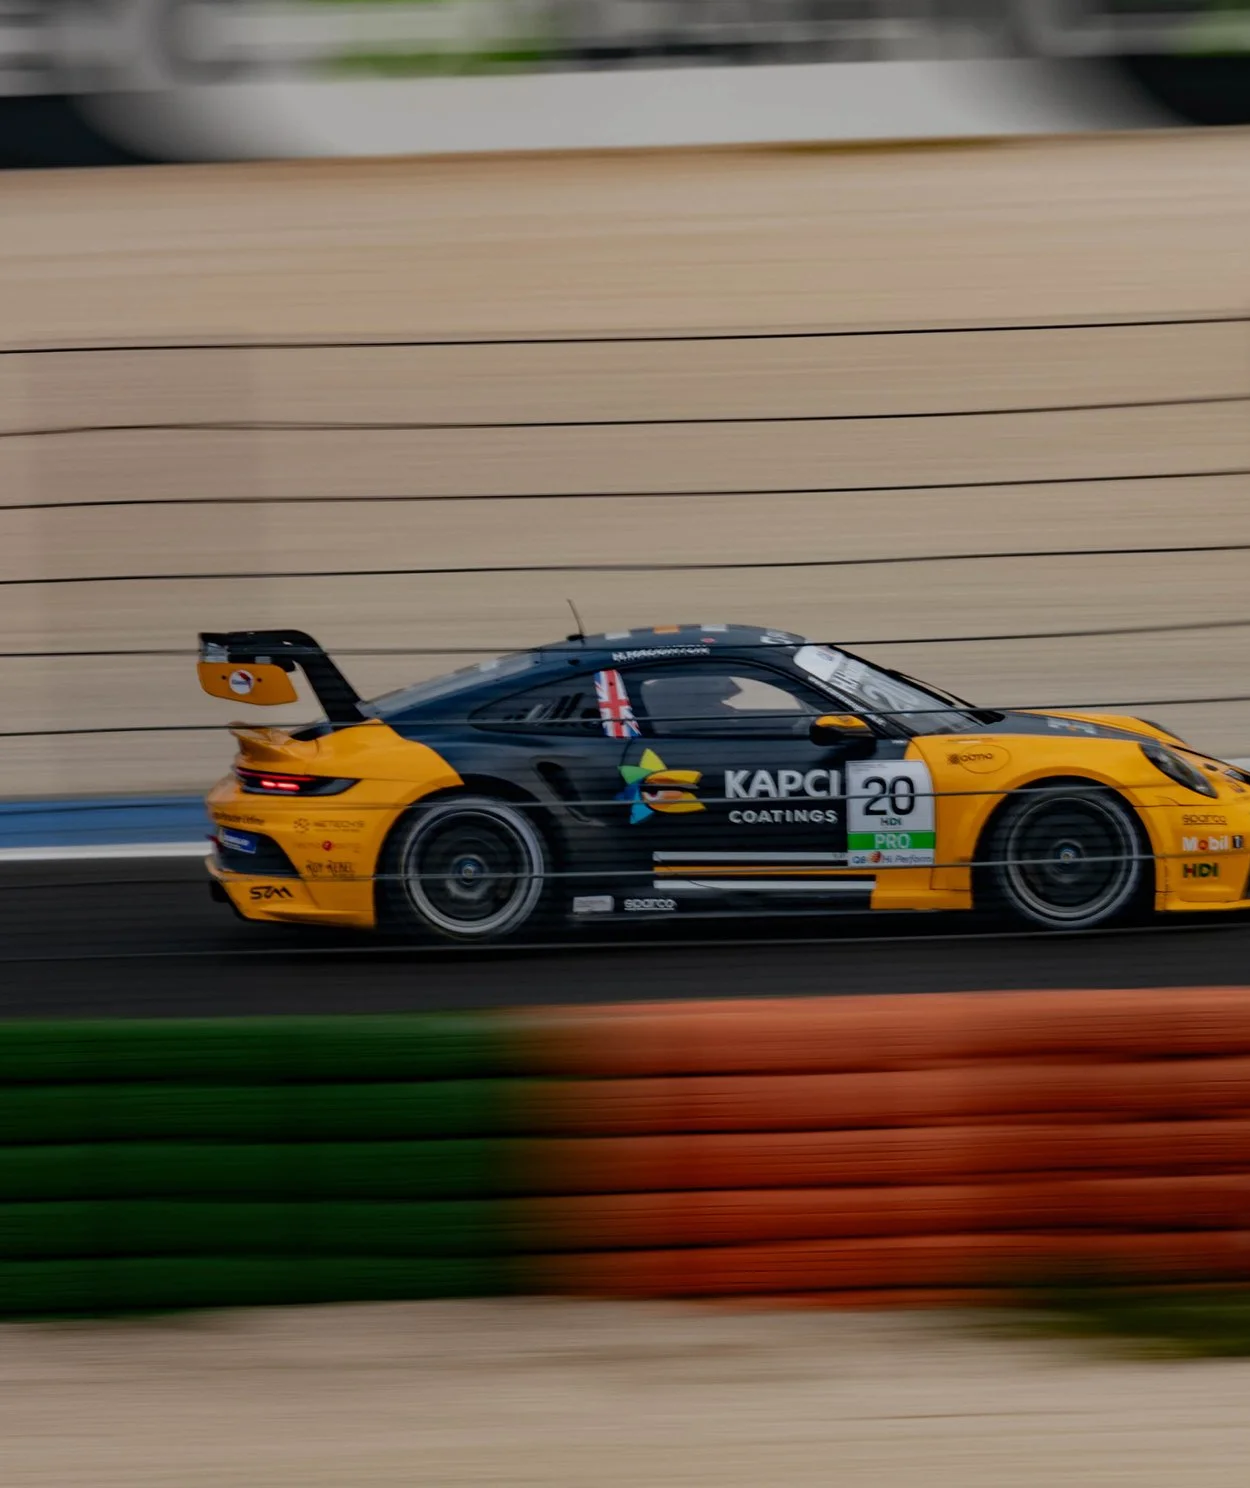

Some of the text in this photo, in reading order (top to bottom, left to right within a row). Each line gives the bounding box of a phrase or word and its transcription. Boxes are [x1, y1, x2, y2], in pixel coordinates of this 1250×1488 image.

[724, 769, 841, 798] KAPCI
[862, 776, 915, 815] 20
[728, 809, 838, 824] COATINGS
[880, 818, 902, 826] HDI
[873, 833, 912, 849] PRO
[1182, 836, 1229, 851] Mobil
[1182, 863, 1219, 878] HDI
[624, 899, 677, 911] sparco
